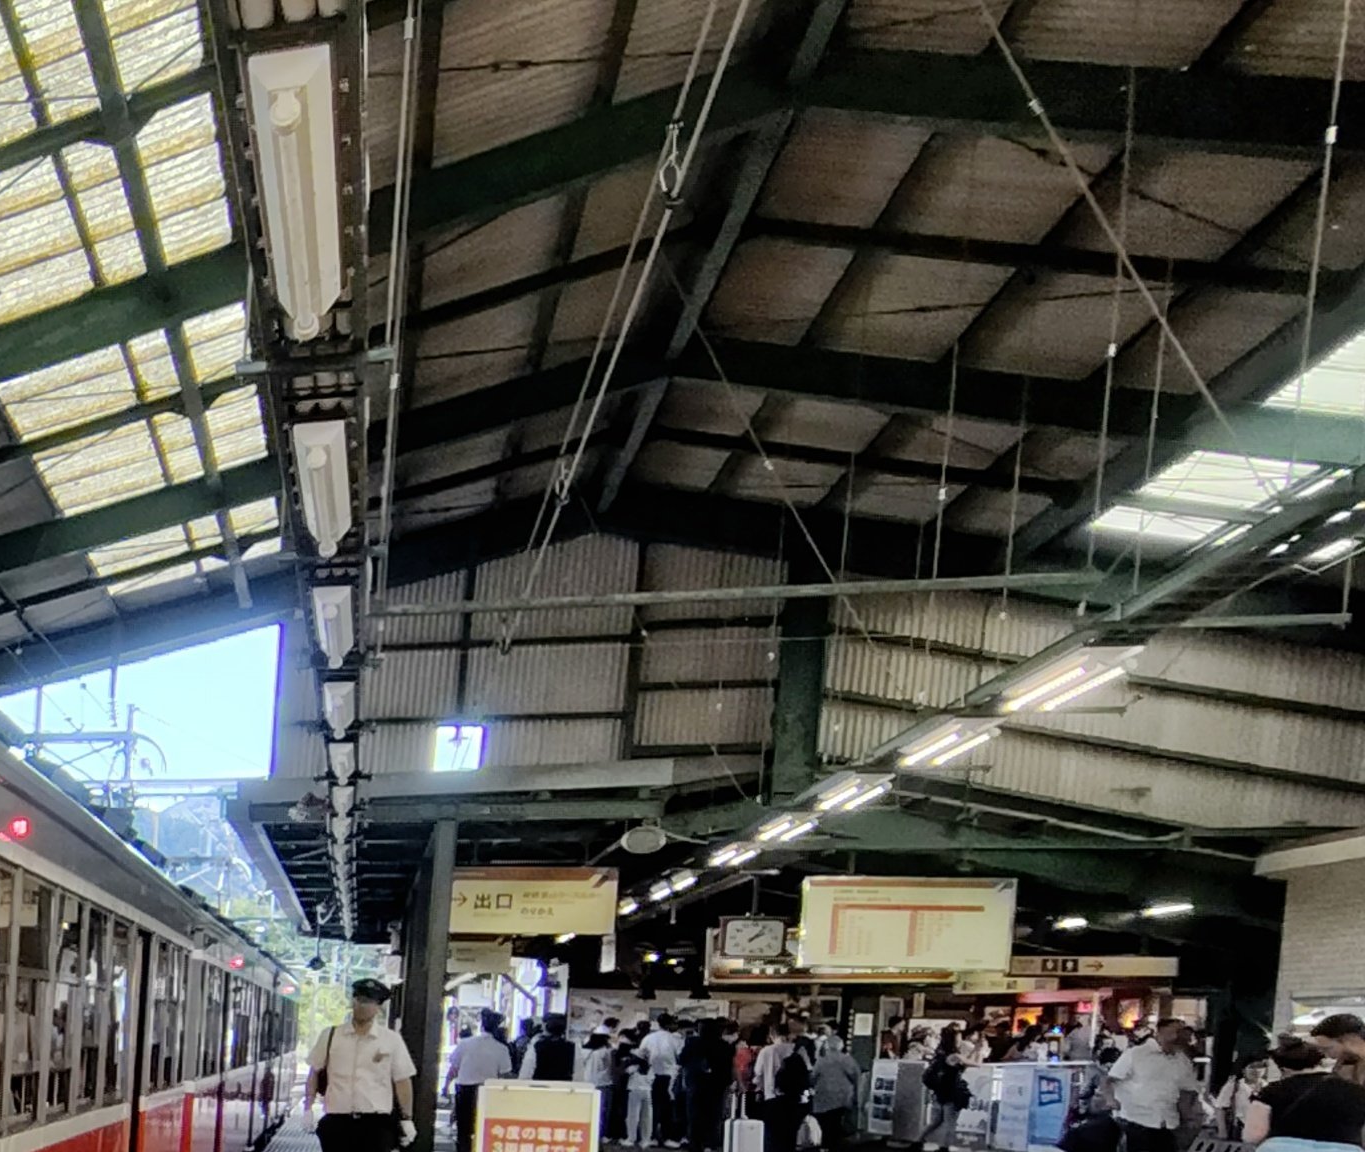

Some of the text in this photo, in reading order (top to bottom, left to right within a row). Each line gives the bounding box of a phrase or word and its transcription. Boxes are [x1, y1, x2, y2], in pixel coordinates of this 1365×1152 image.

[474, 893, 513, 909] 出口
[491, 1124, 584, 1143] 今度の電車は
